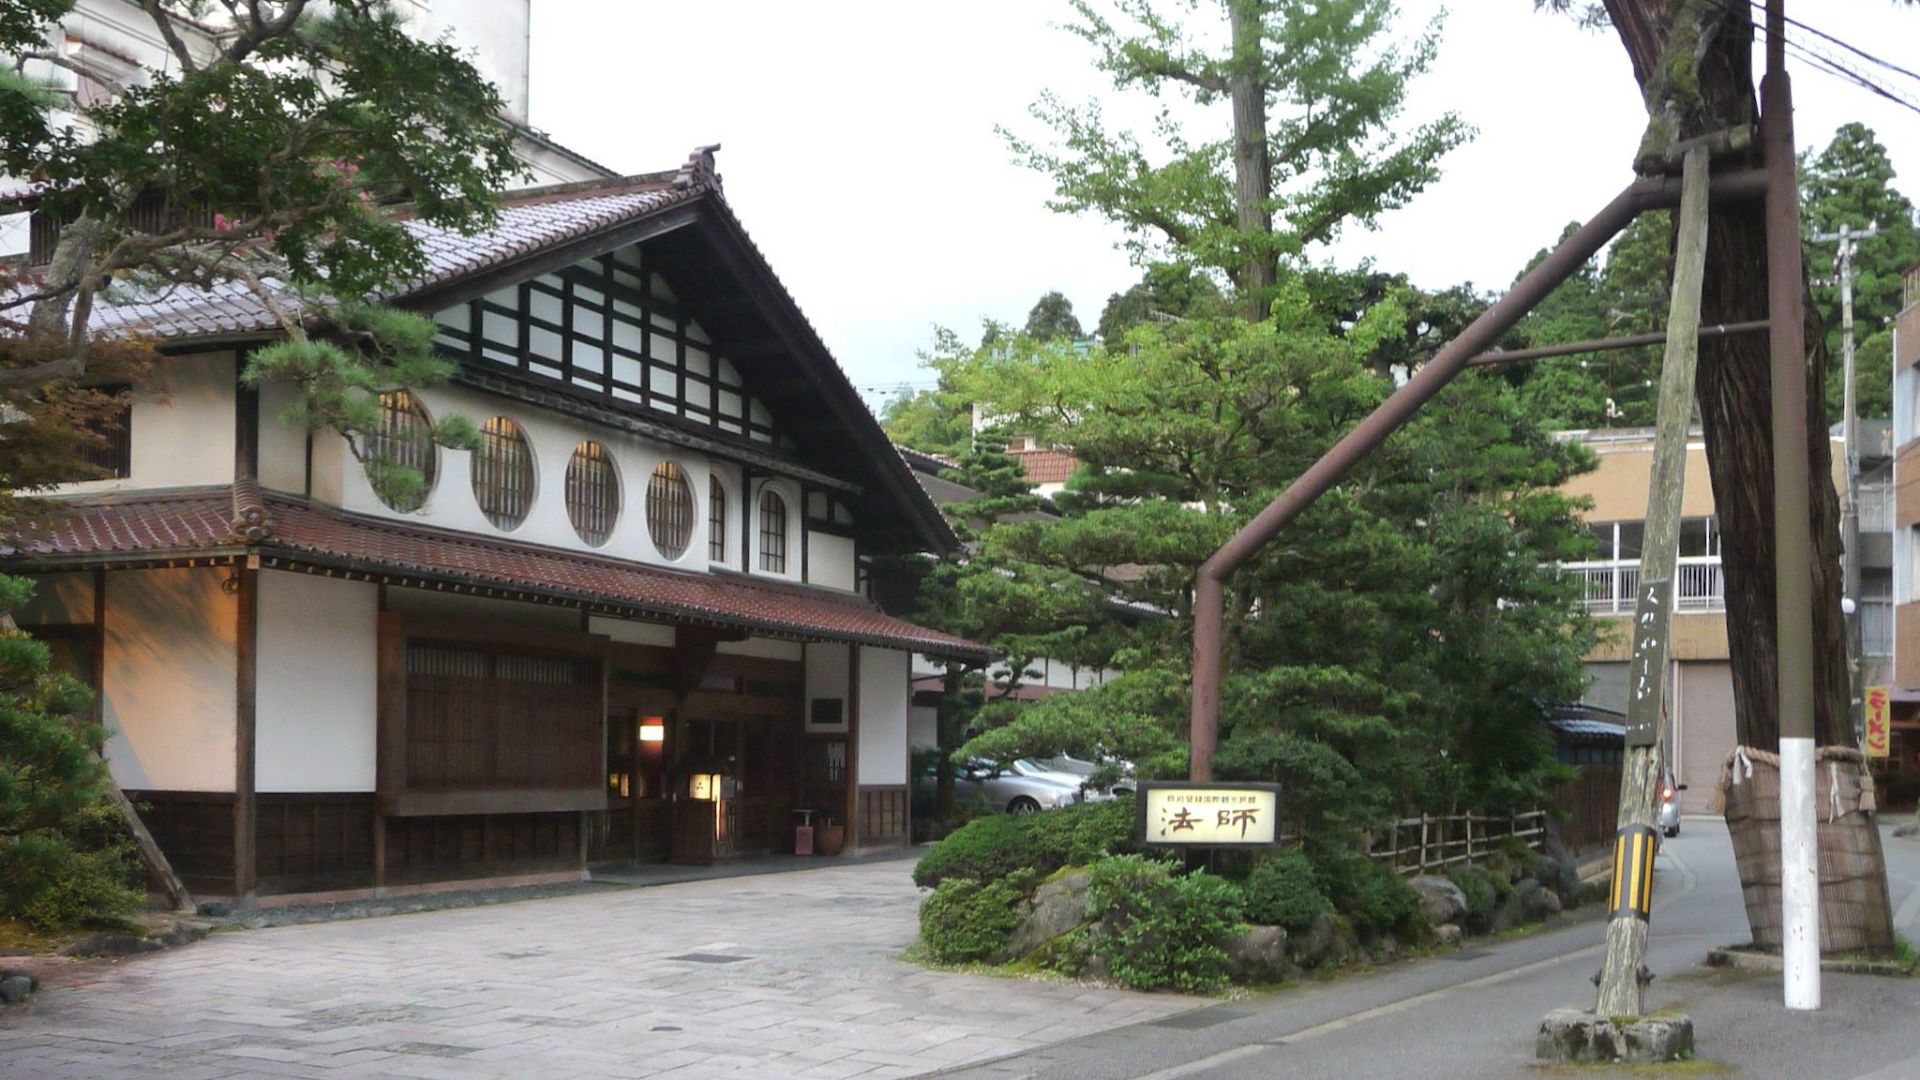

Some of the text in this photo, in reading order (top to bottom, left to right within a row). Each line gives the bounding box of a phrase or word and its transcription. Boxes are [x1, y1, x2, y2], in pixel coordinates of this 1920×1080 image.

[1868, 691, 1886, 750] ラーメン
[1160, 806, 1261, 839] 法師
